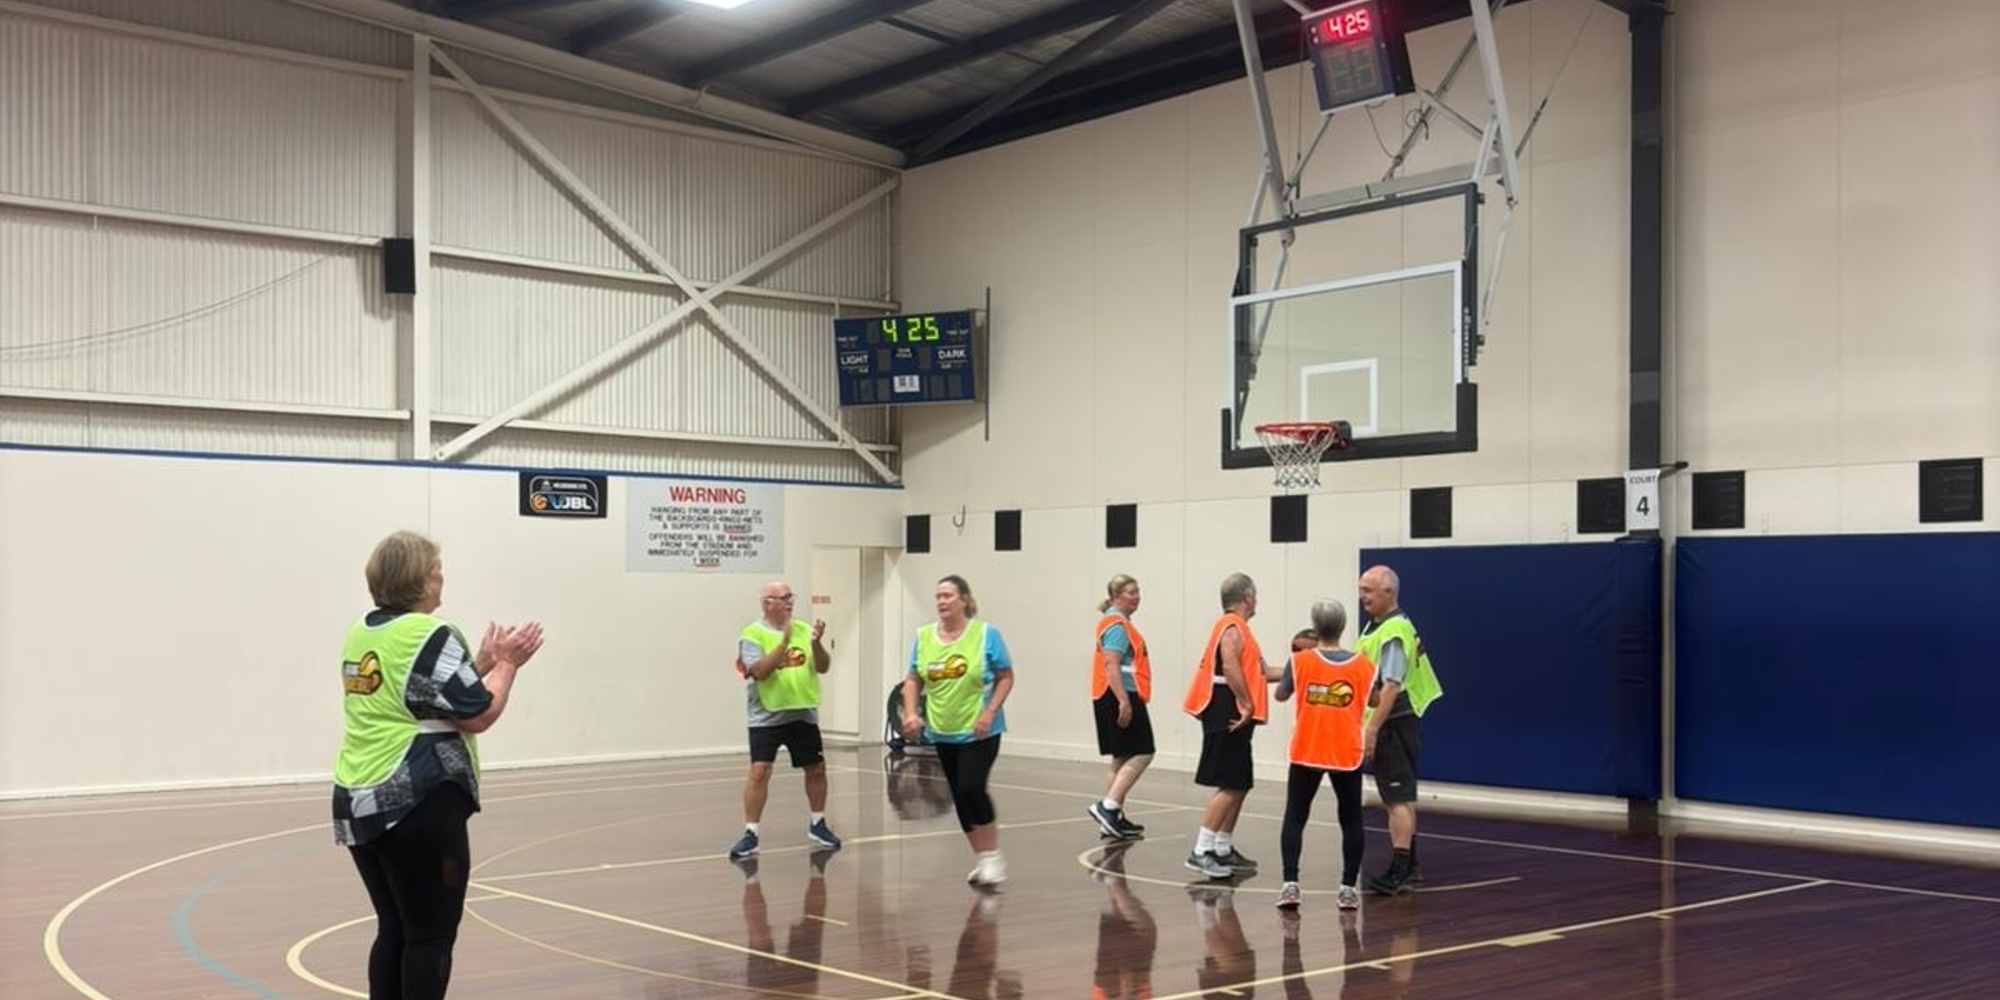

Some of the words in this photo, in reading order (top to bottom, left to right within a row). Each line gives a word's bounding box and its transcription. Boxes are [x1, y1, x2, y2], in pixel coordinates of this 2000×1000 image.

[938, 349, 966, 359] DARK
[841, 354, 868, 365] LIGHT
[1630, 475, 1656, 484] COURT
[669, 486, 746, 504] WARNING
[651, 506, 686, 514] HANGING
[1636, 496, 1650, 516] 4
[649, 533, 694, 541] OFFENDERS
